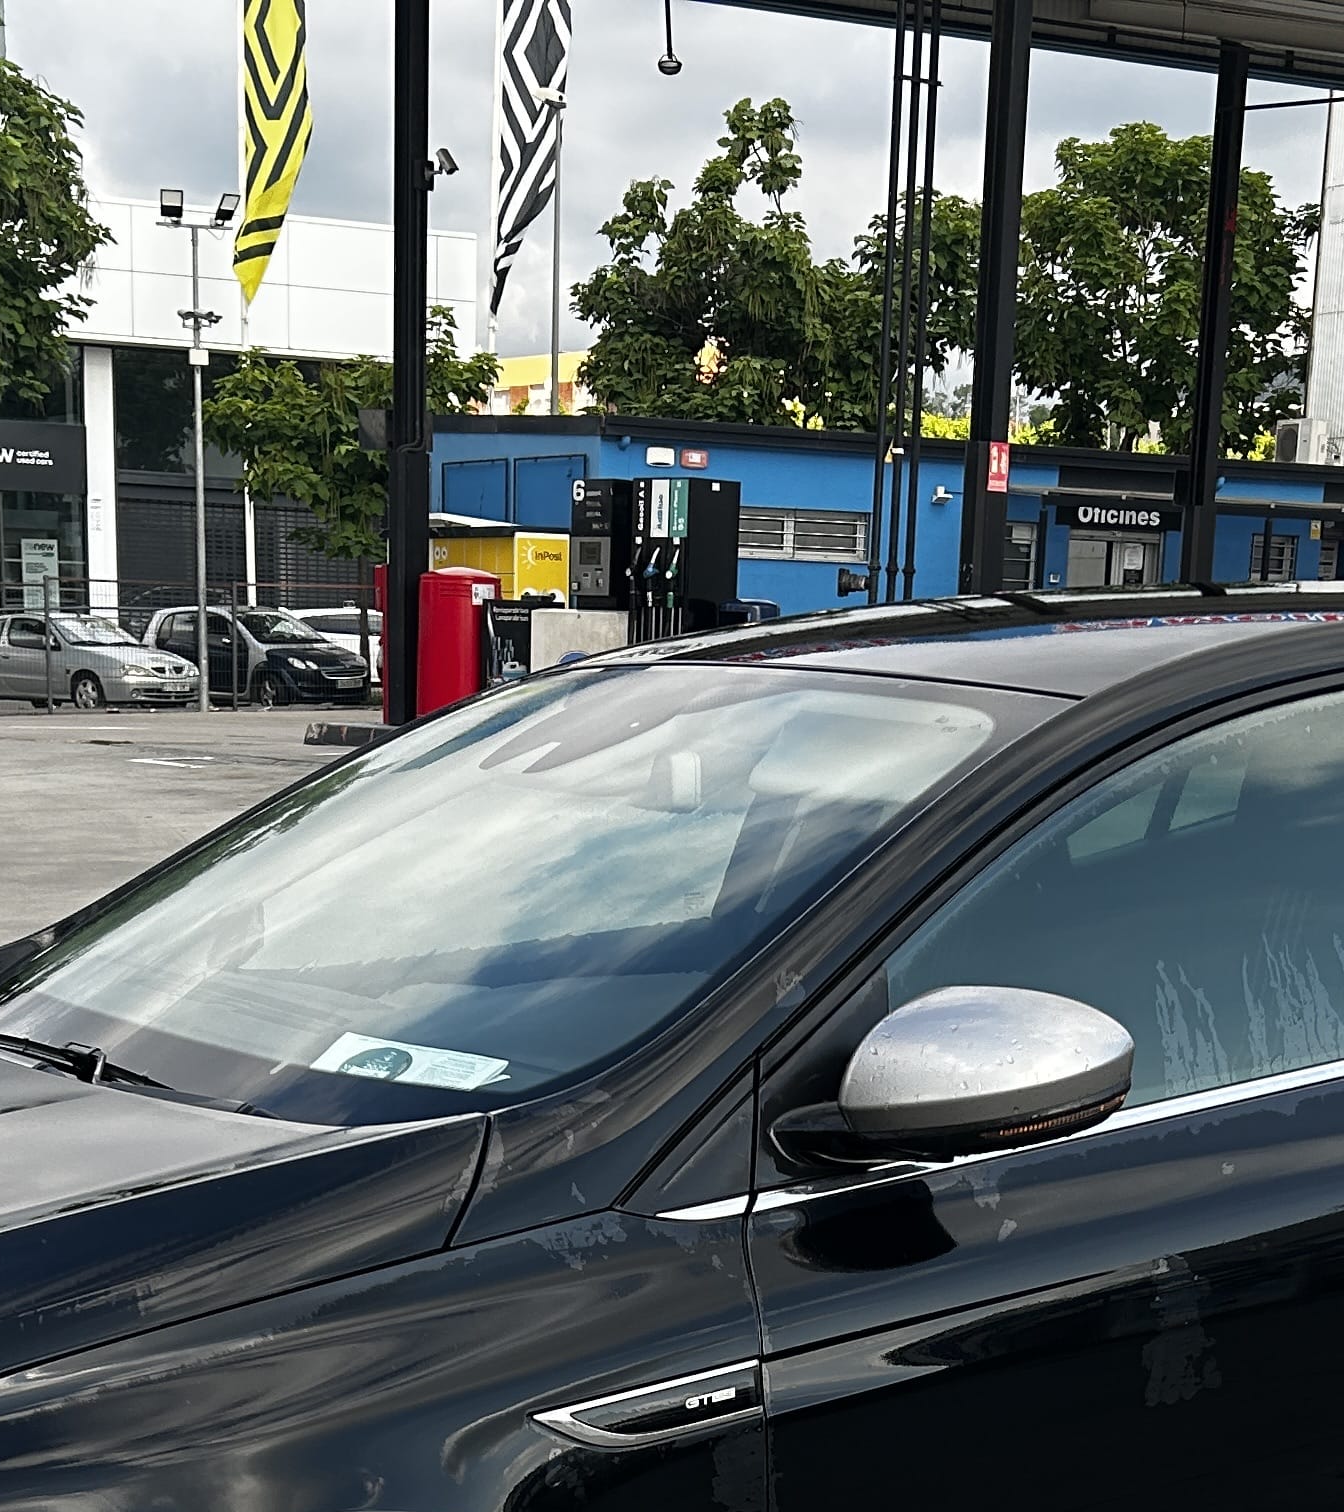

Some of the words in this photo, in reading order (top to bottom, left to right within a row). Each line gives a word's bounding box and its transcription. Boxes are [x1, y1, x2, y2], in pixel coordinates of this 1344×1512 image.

[573, 480, 585, 501] 6
[1078, 506, 1161, 526] Oficines
[535, 551, 563, 562] InPost
[685, 1393, 713, 1409] GT
